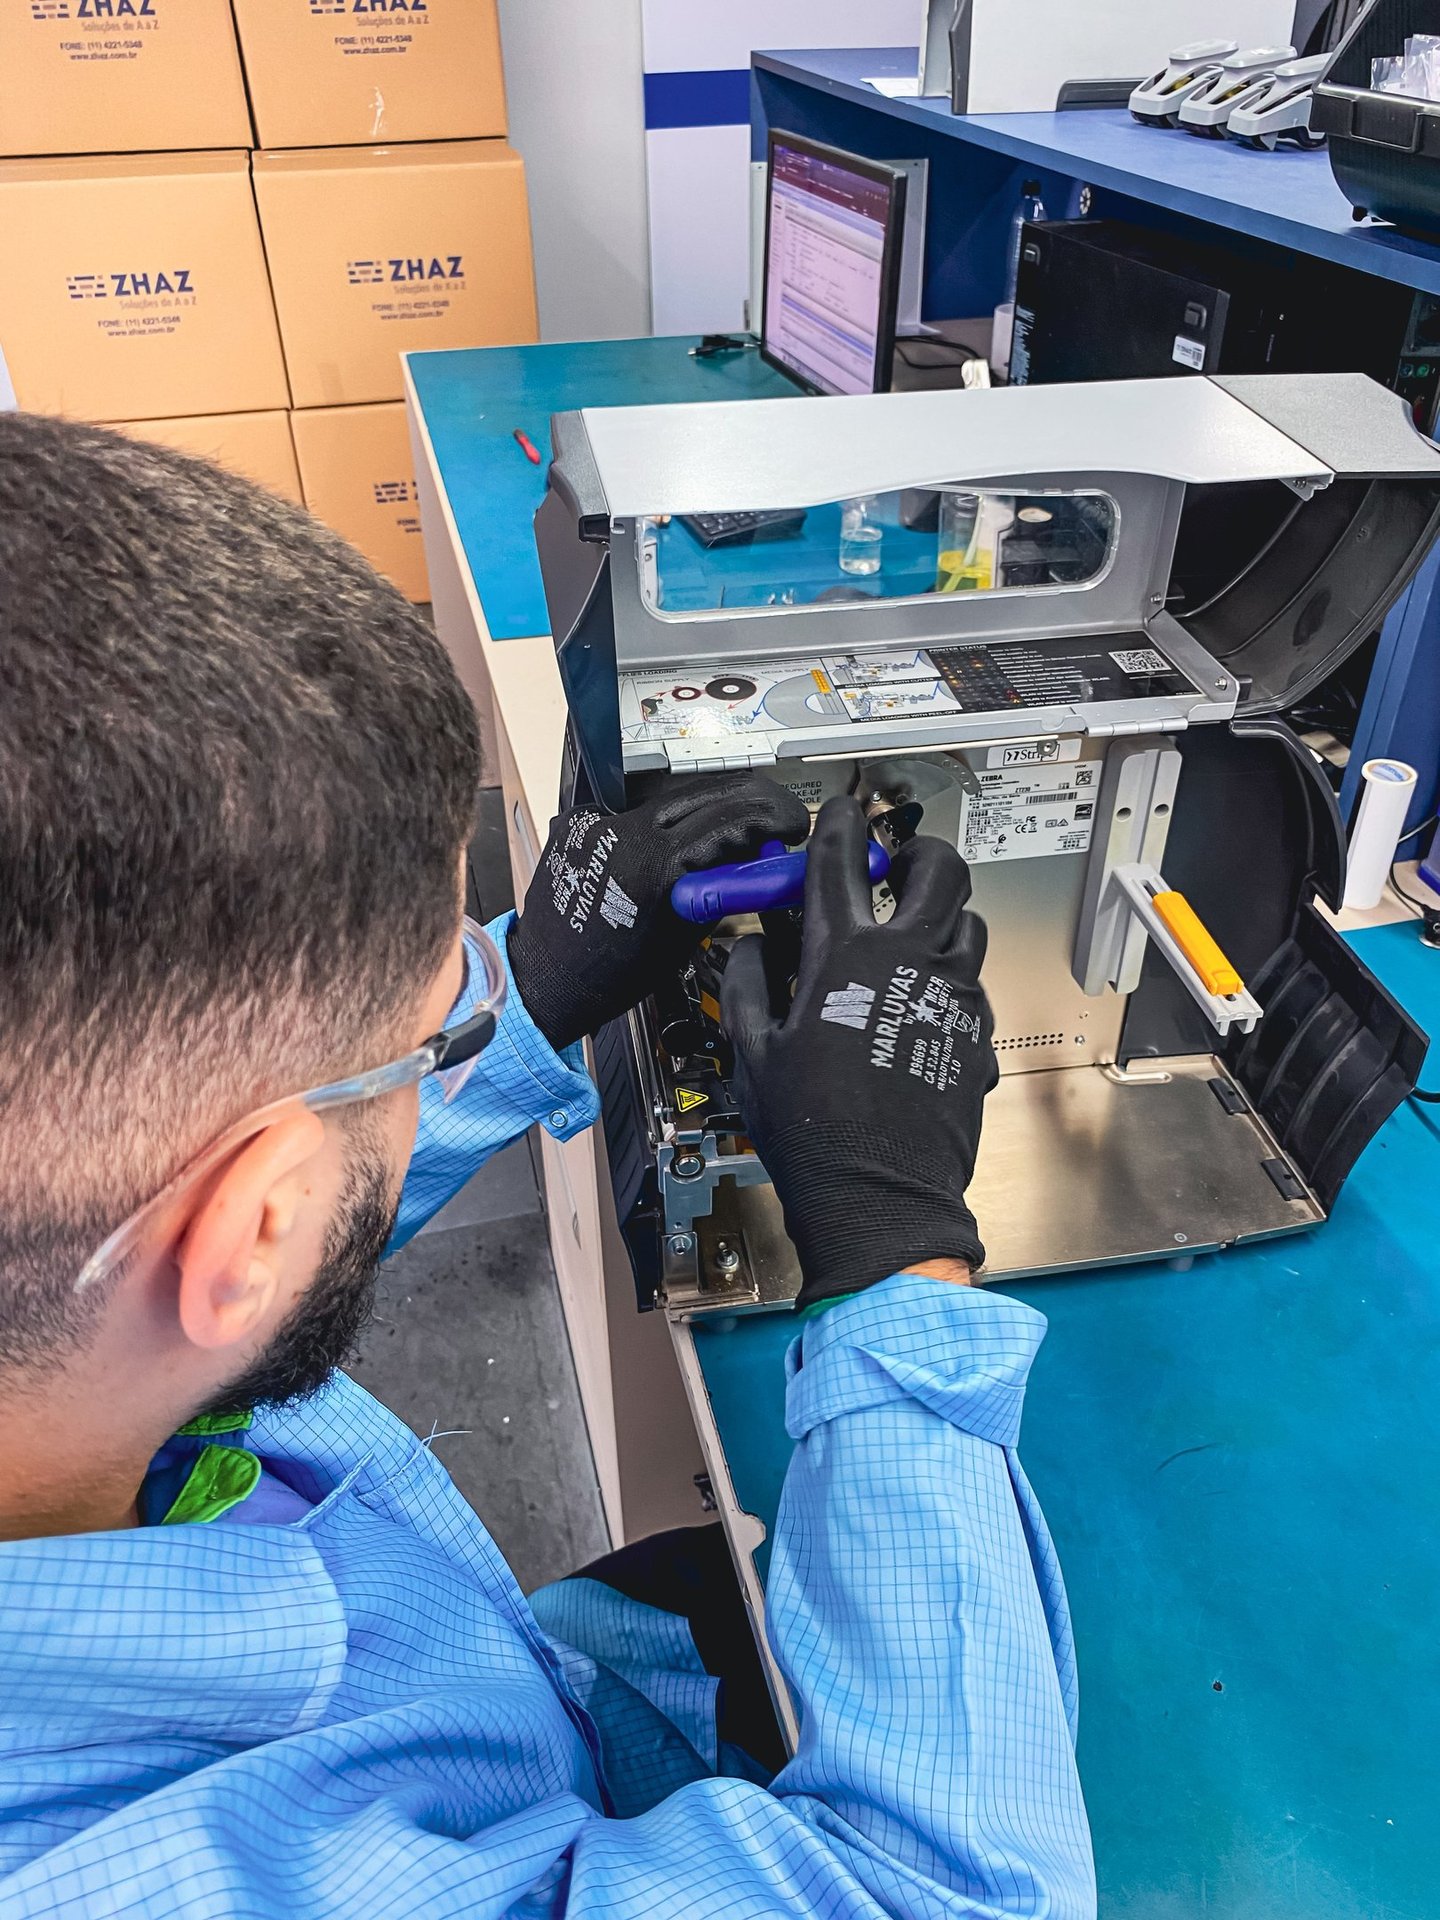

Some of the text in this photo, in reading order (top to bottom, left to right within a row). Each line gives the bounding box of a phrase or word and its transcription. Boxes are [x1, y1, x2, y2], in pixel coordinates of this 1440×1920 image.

[77, 0, 156, 17] ZHAZ
[388, 256, 465, 282] ZHAZ
[110, 270, 194, 297] ZHAZ
[785, 780, 823, 790] EQUIRED
[981, 774, 1003, 782] ZEBRA
[569, 828, 619, 934] MARLUVAS
[922, 975, 945, 1004] MCR
[937, 982, 954, 1009] SAFETY
[870, 965, 919, 1069] MARLUVAS
